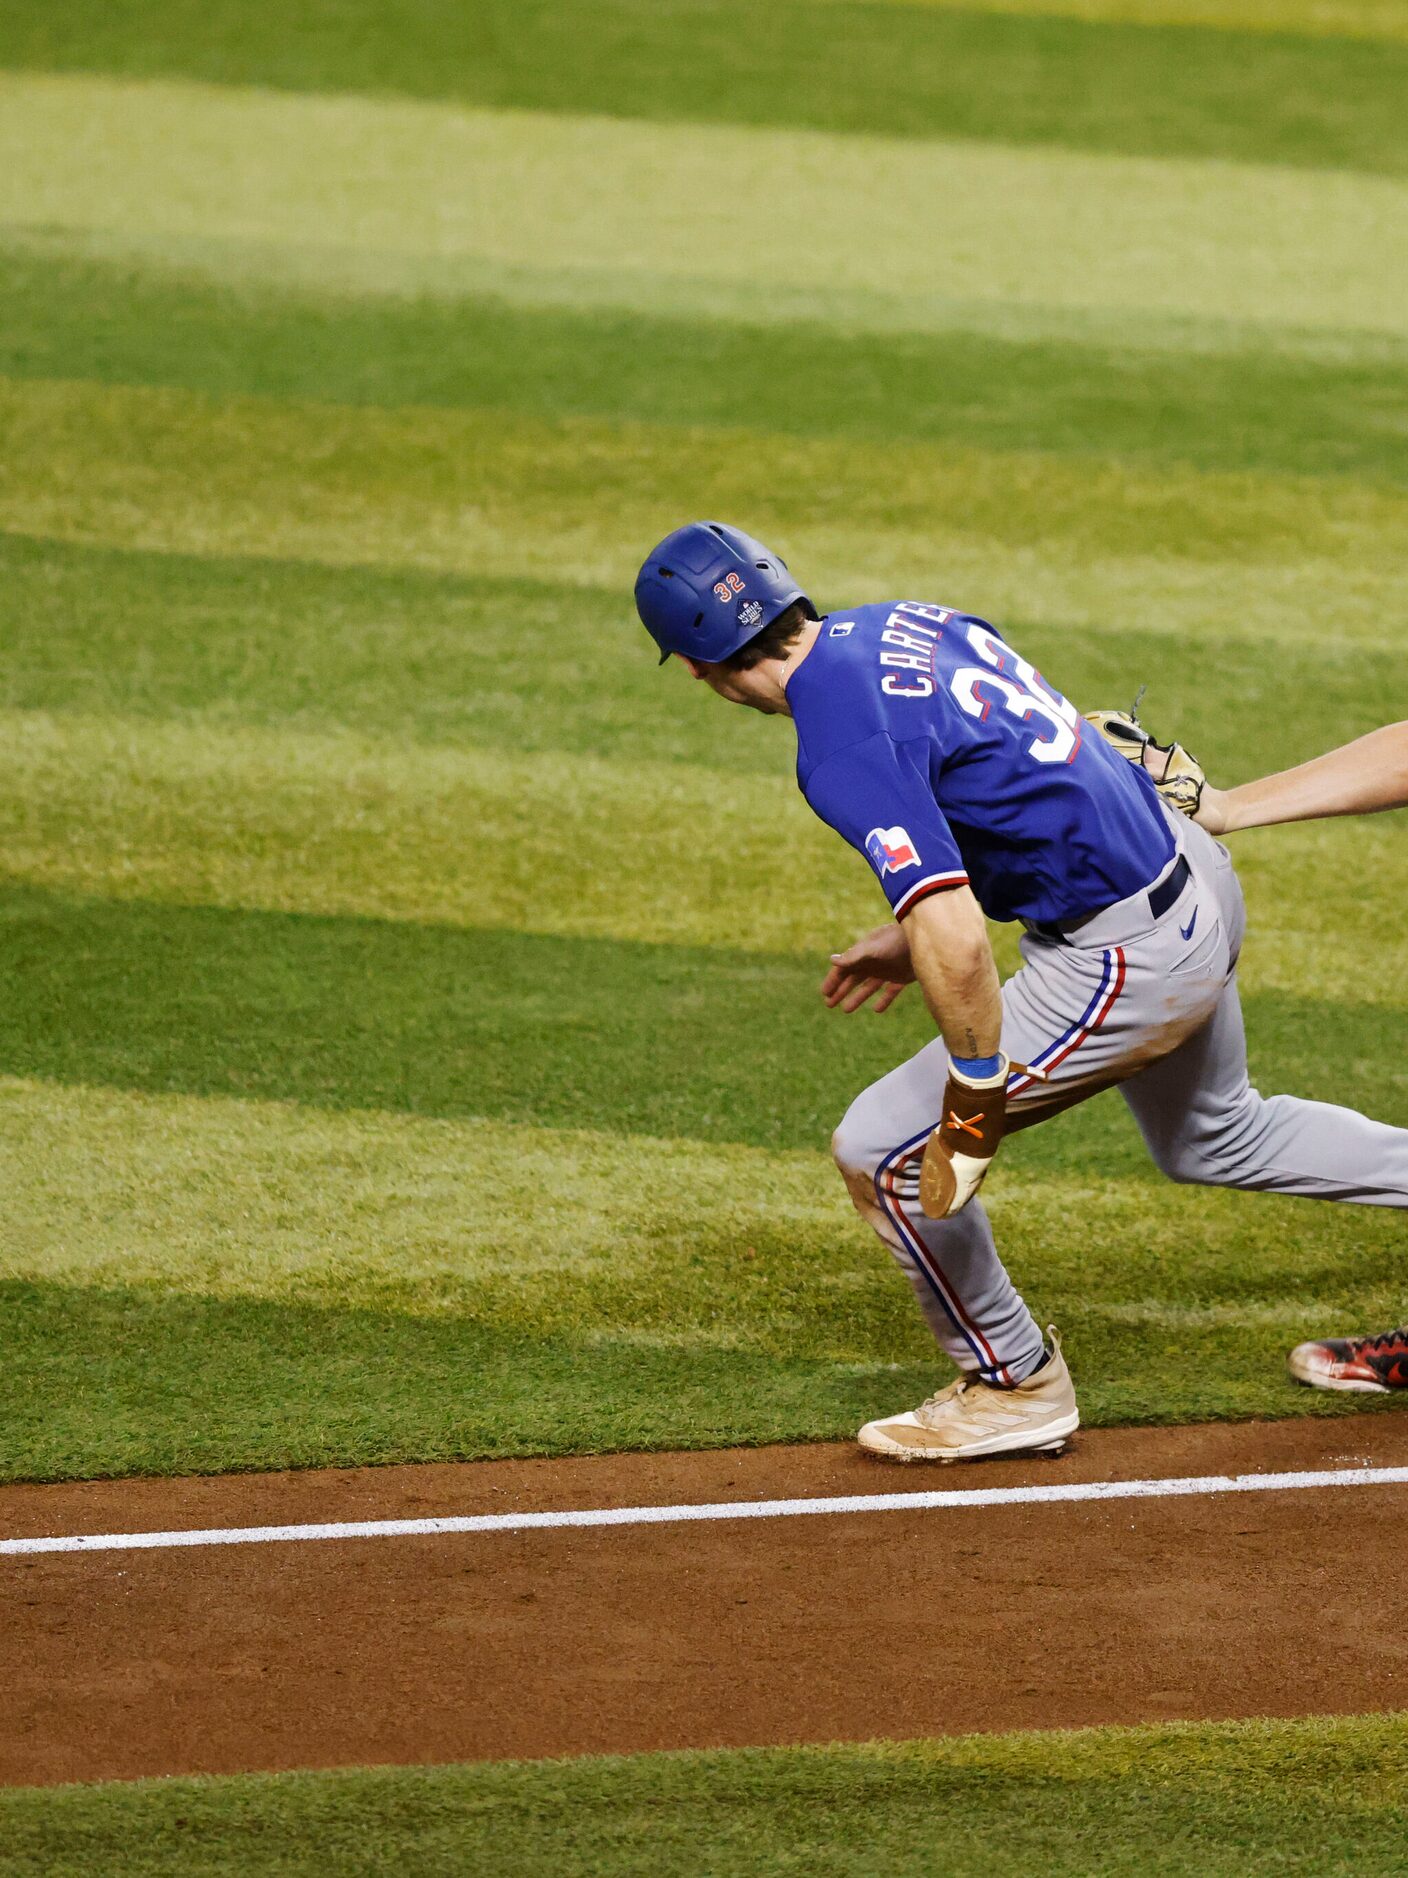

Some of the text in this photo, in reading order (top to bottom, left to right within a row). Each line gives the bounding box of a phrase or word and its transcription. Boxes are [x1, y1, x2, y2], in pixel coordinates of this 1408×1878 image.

[713, 572, 746, 603] 32
[737, 600, 760, 621] WORLD
[879, 600, 960, 698] CARTE
[949, 621, 1082, 765] 32
